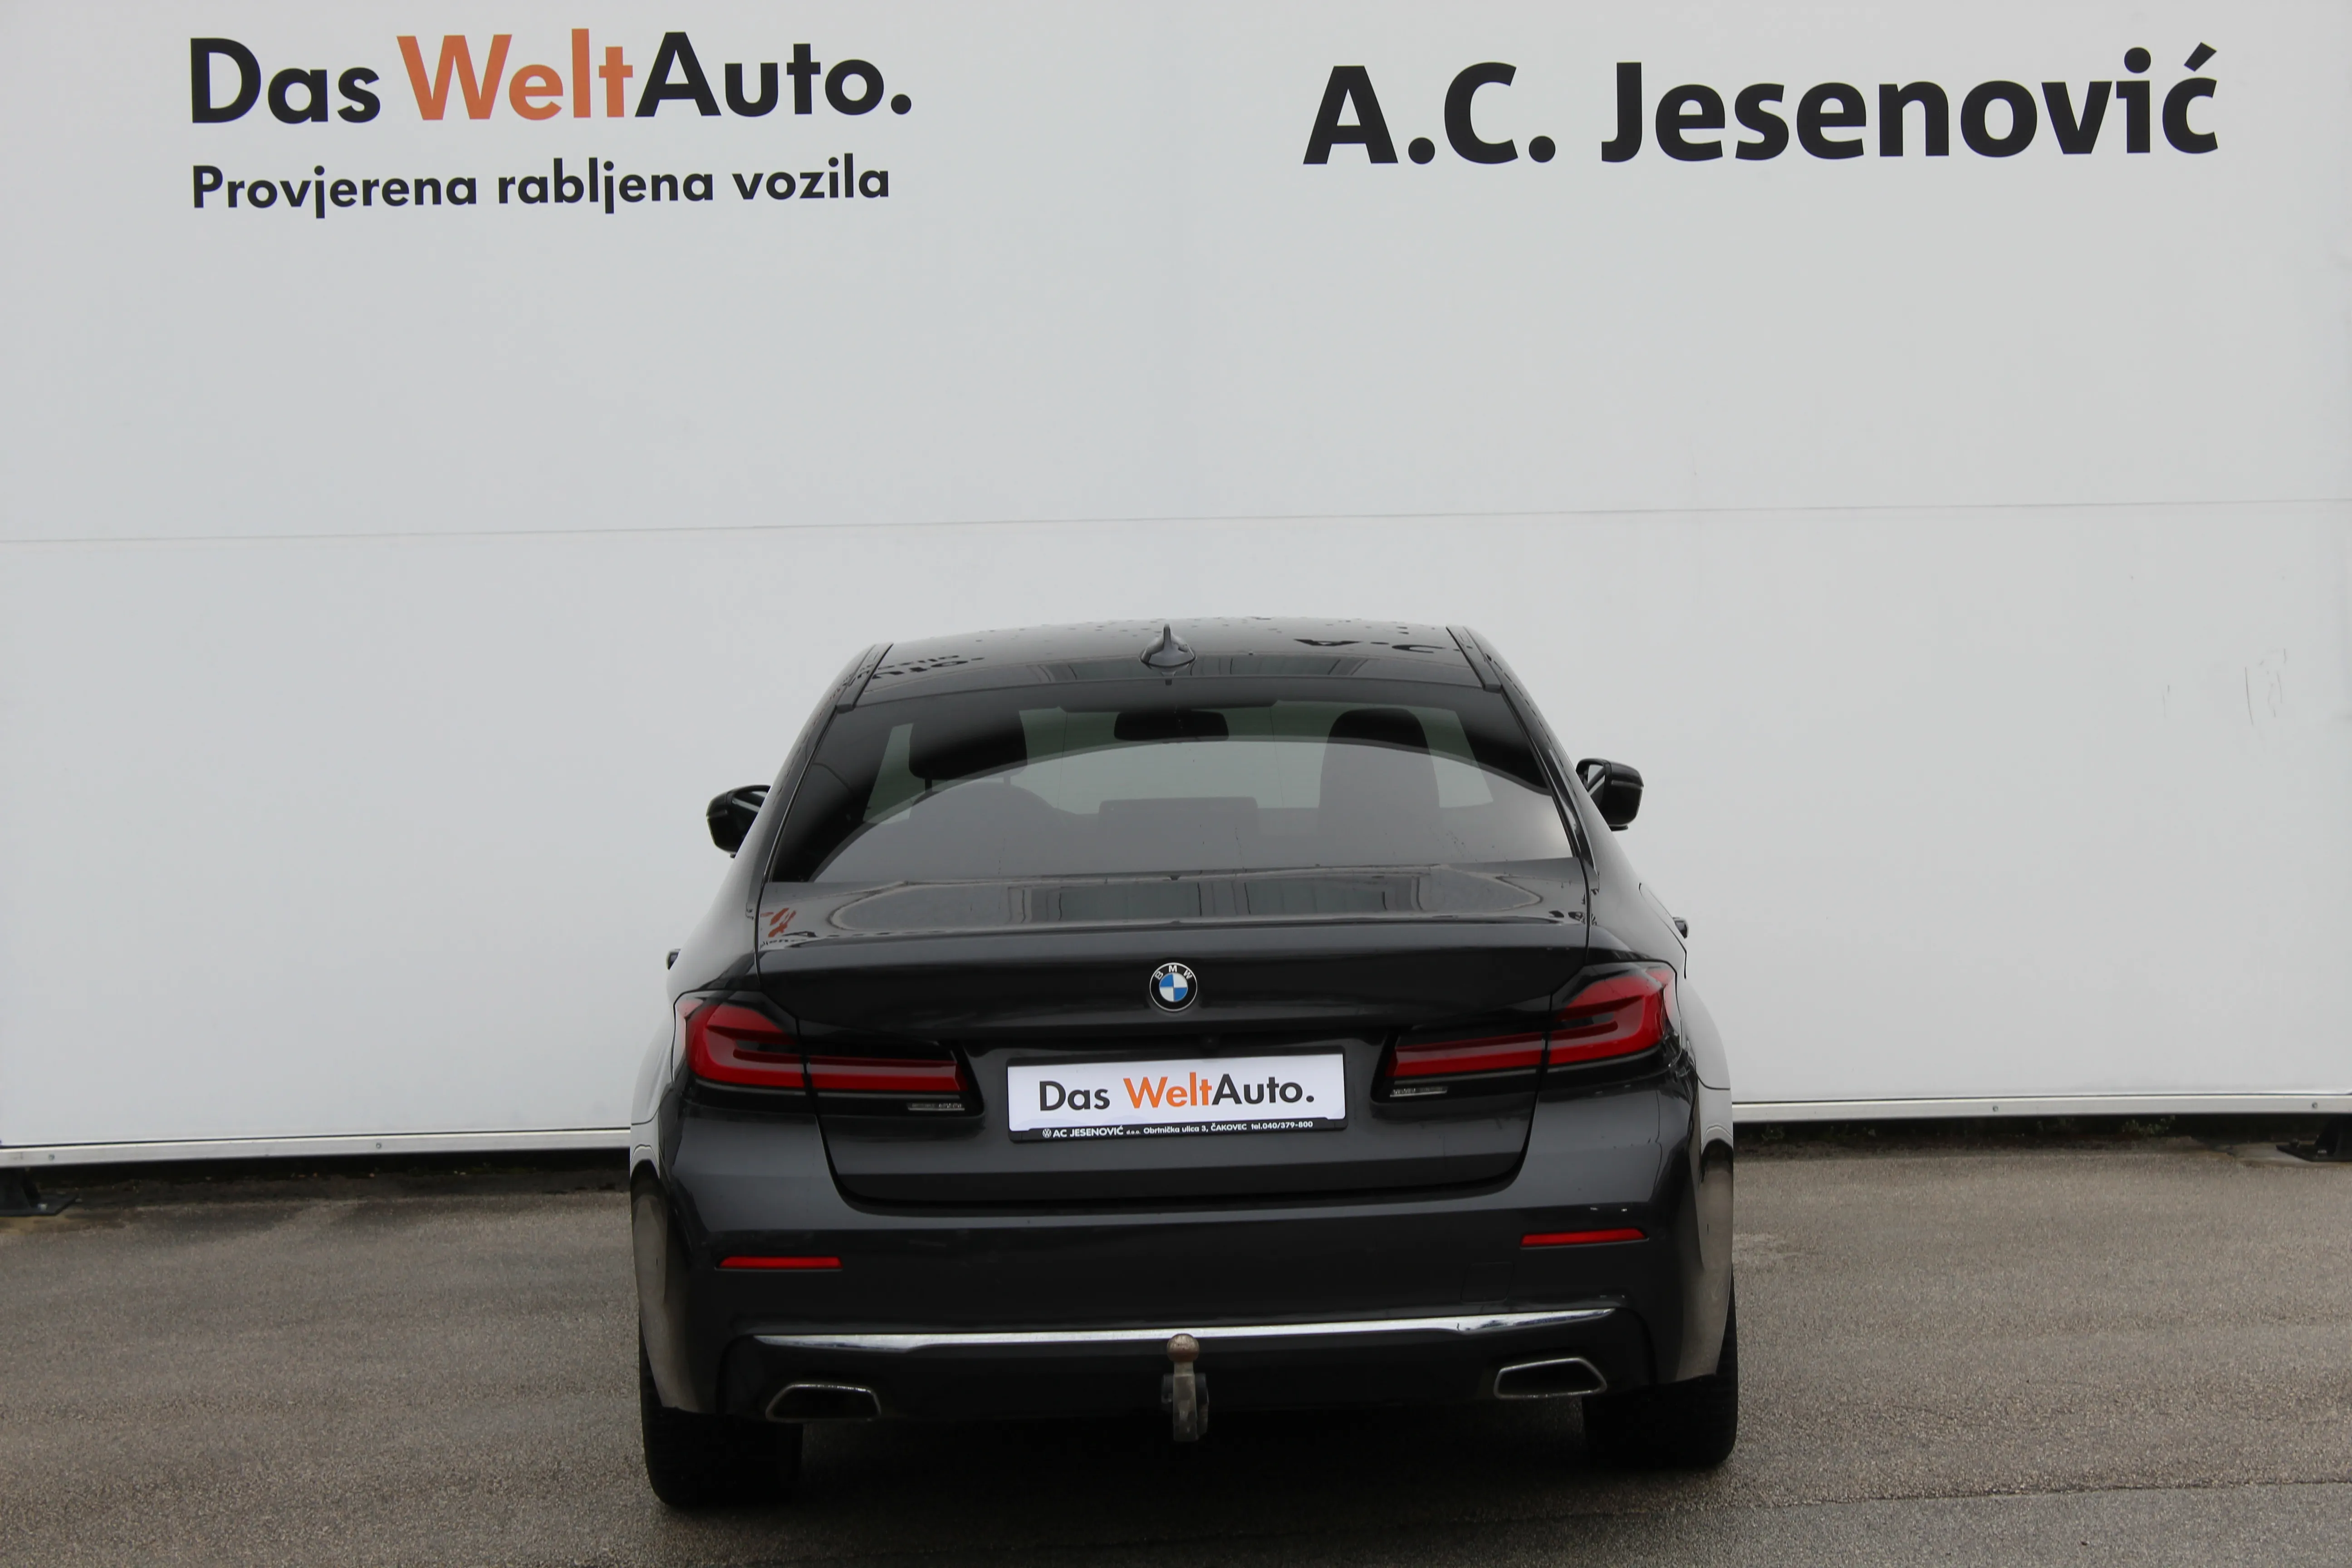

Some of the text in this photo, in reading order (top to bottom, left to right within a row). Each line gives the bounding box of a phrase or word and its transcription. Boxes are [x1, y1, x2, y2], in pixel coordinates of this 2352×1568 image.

[190, 28, 912, 124] Das WeltAuto.
[1303, 42, 2218, 165] A.C. Jesenović
[193, 153, 889, 219] Provjerena rabljena vozila
[1154, 965, 1193, 980] BMW
[1039, 1071, 1315, 1111] Das WeltAuto.
[1053, 1129, 1067, 1137] AC
[1069, 1125, 1123, 1137] JESENOVIĆ
[1143, 1125, 1180, 1134] Obrtnička
[1210, 1122, 1247, 1132] ČAKOVEC
[1251, 1121, 1313, 1130] tel.040/379-800
